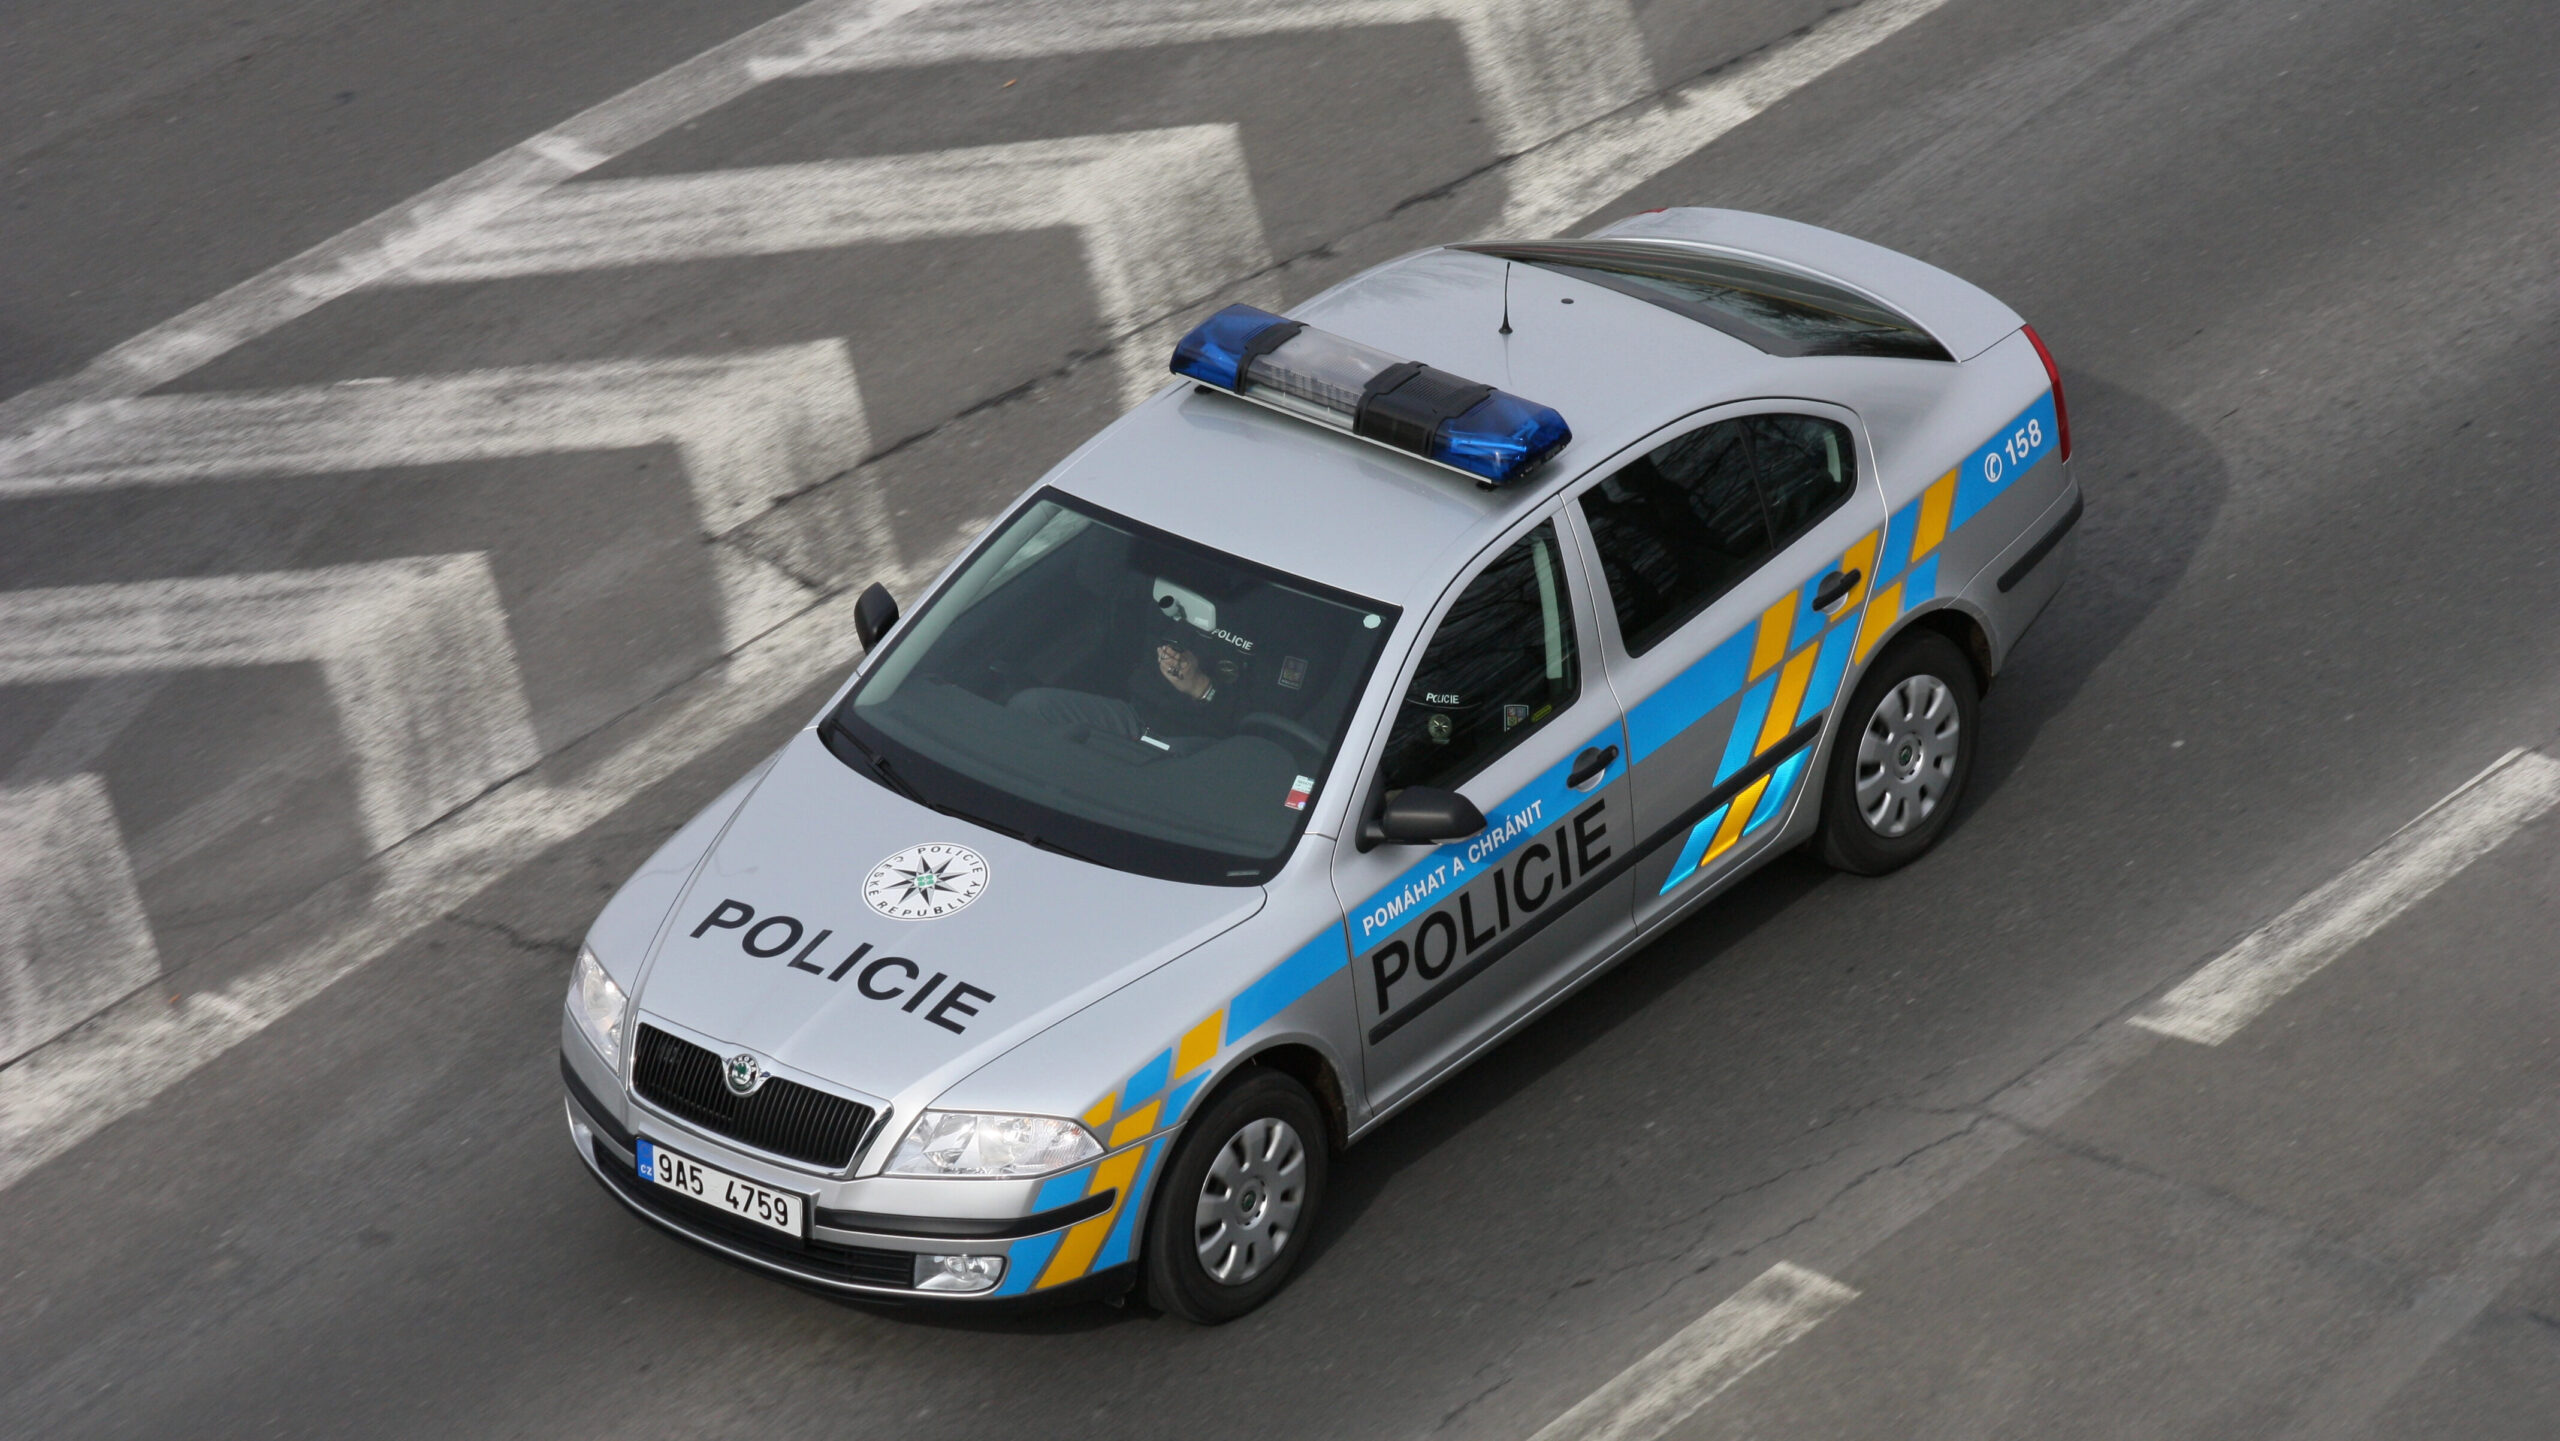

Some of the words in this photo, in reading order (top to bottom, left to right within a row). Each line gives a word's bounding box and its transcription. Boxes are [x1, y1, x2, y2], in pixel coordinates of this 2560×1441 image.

[2005, 418, 2042, 466] 158
[917, 846, 983, 873] POLICIE
[1362, 865, 1447, 937] POMÁHAT
[1452, 857, 1465, 877] A
[1467, 799, 1543, 865] CHRÁNIT
[876, 881, 981, 917] REPUBLIKY
[1371, 797, 1612, 1016] POLICIE
[690, 898, 996, 1035] POLICIE
[640, 1164, 653, 1177] CZ
[658, 1153, 704, 1196] 9A5
[725, 1180, 788, 1227] 4759
